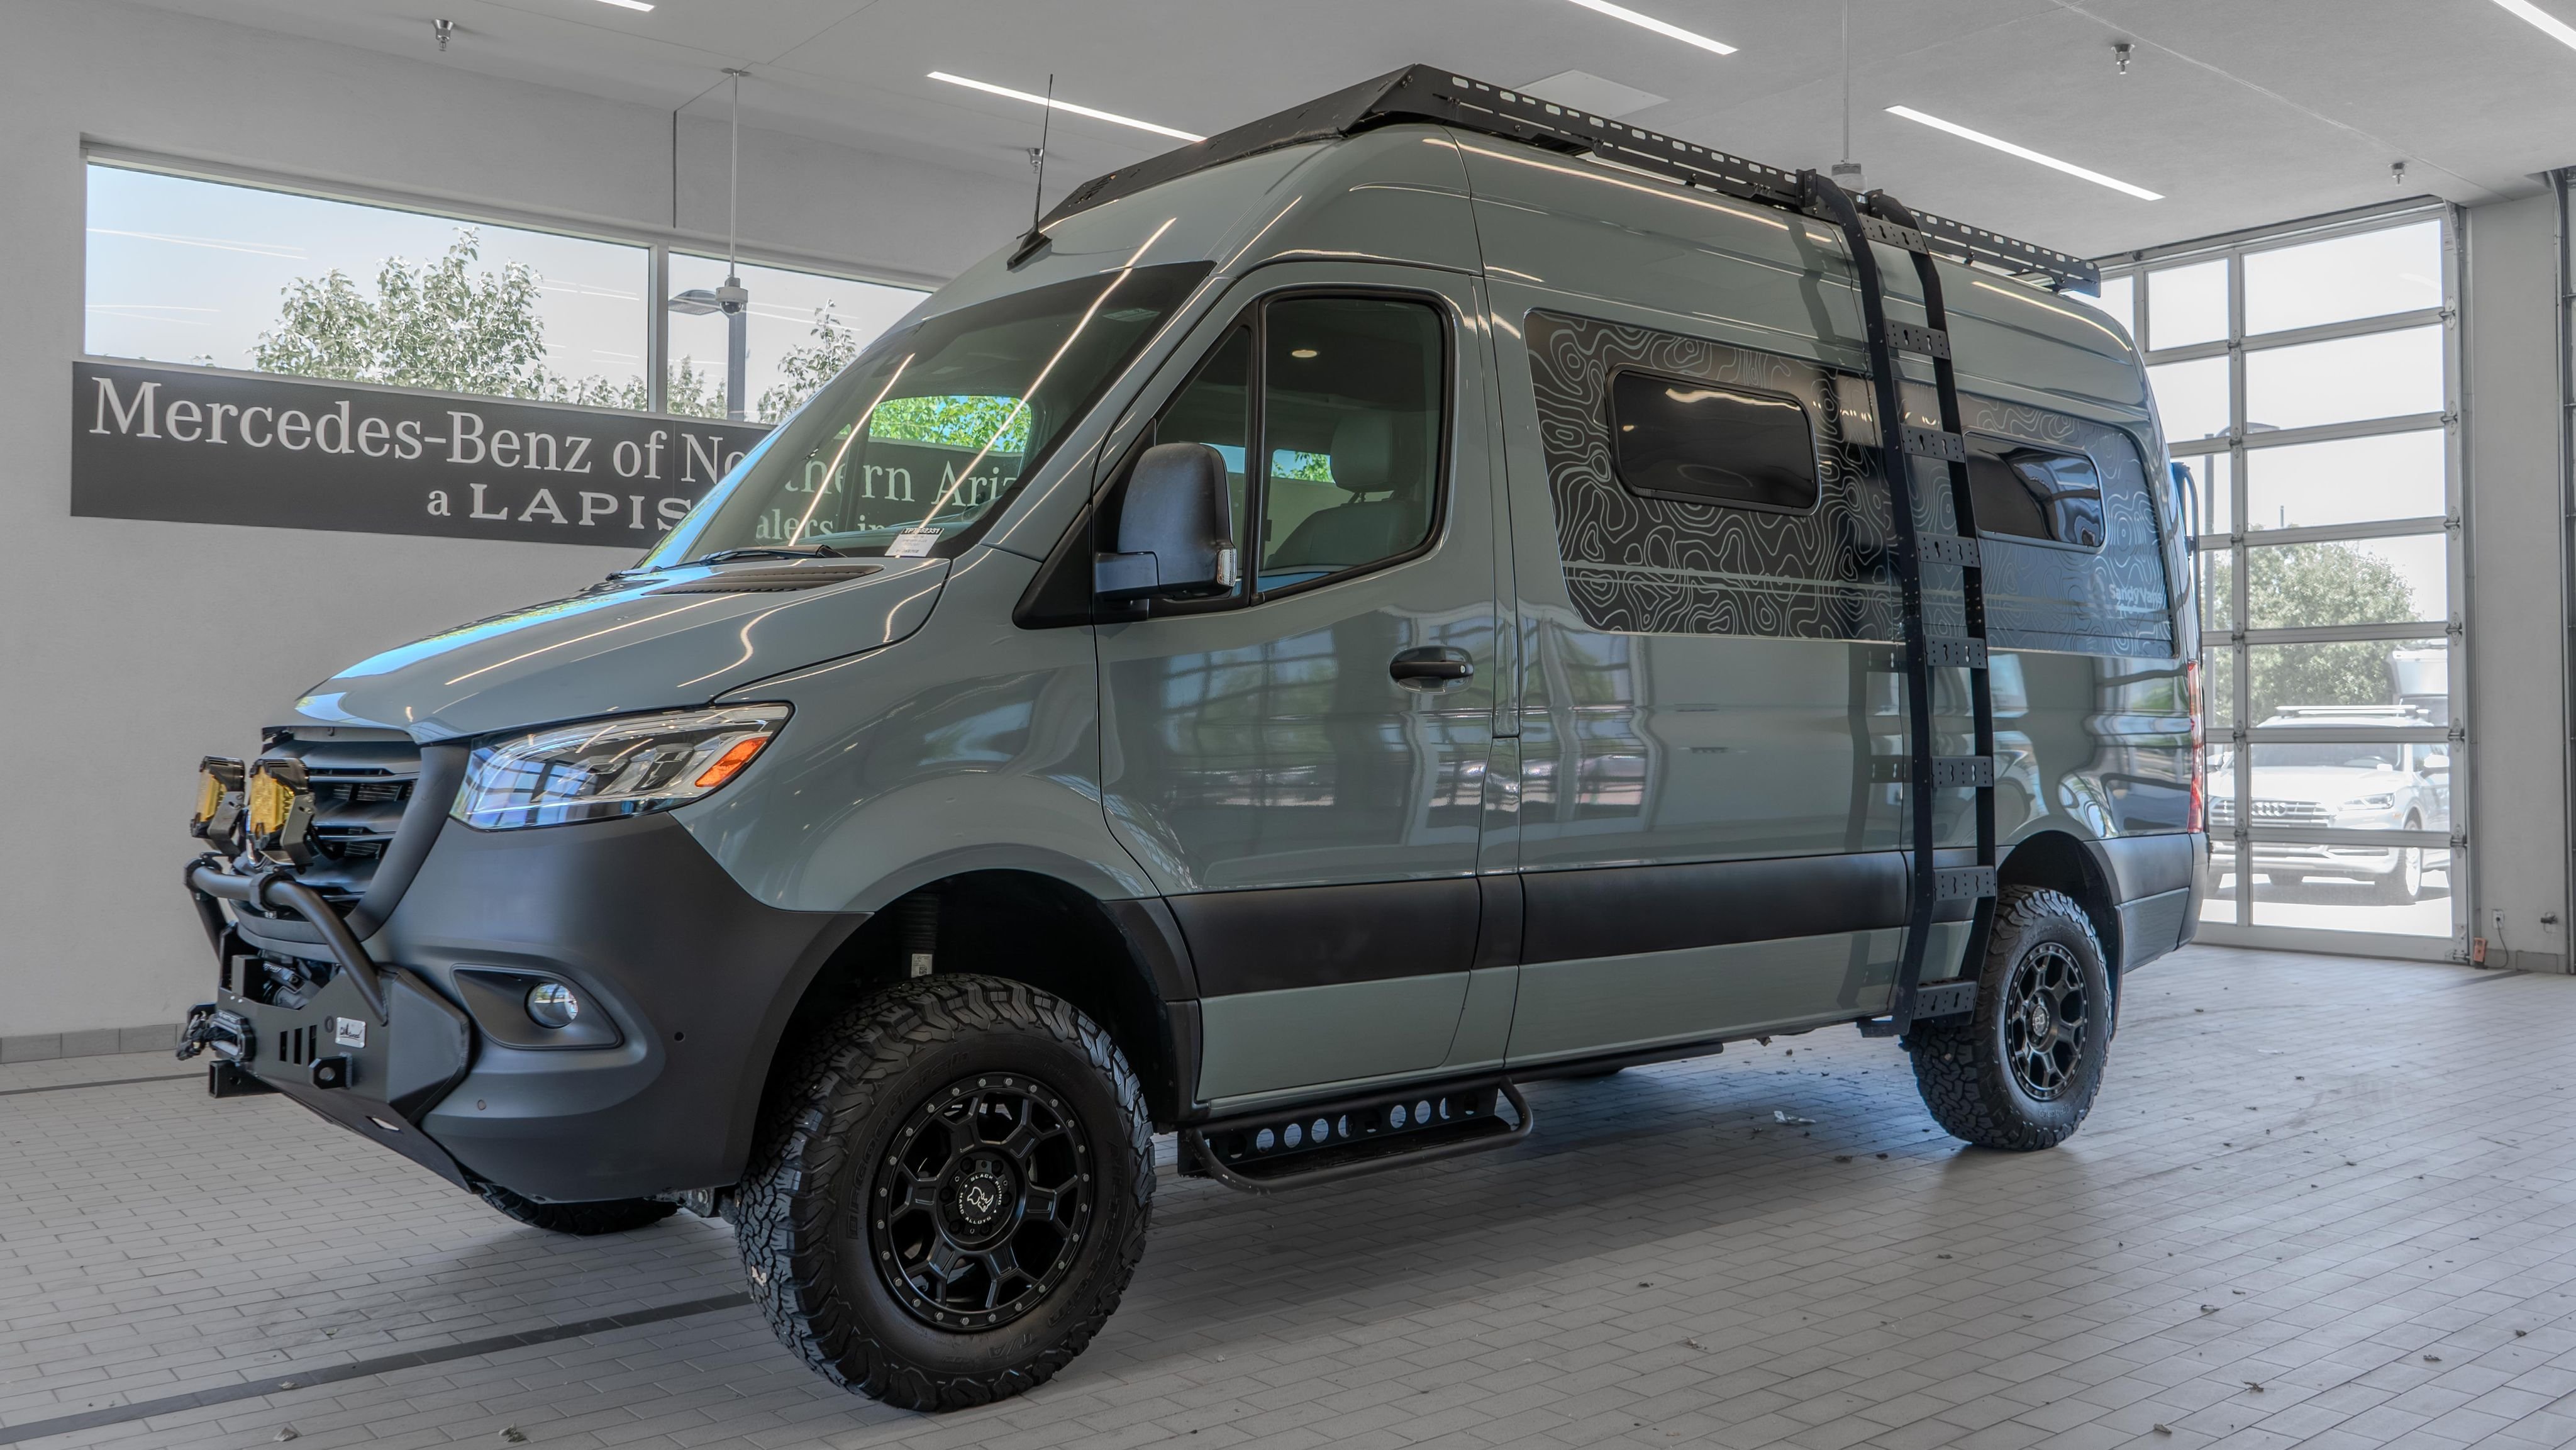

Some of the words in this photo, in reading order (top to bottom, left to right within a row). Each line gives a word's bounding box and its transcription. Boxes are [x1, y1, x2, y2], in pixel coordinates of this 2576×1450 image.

[89, 377, 592, 473] Mercedes-Benz
[613, 430, 668, 480] of
[427, 489, 451, 516] a
[469, 482, 691, 531] LAPIS
[970, 1173, 994, 1182] BLACK
[994, 1181, 1002, 1205] RHINO
[965, 1215, 992, 1225] ALLOYS
